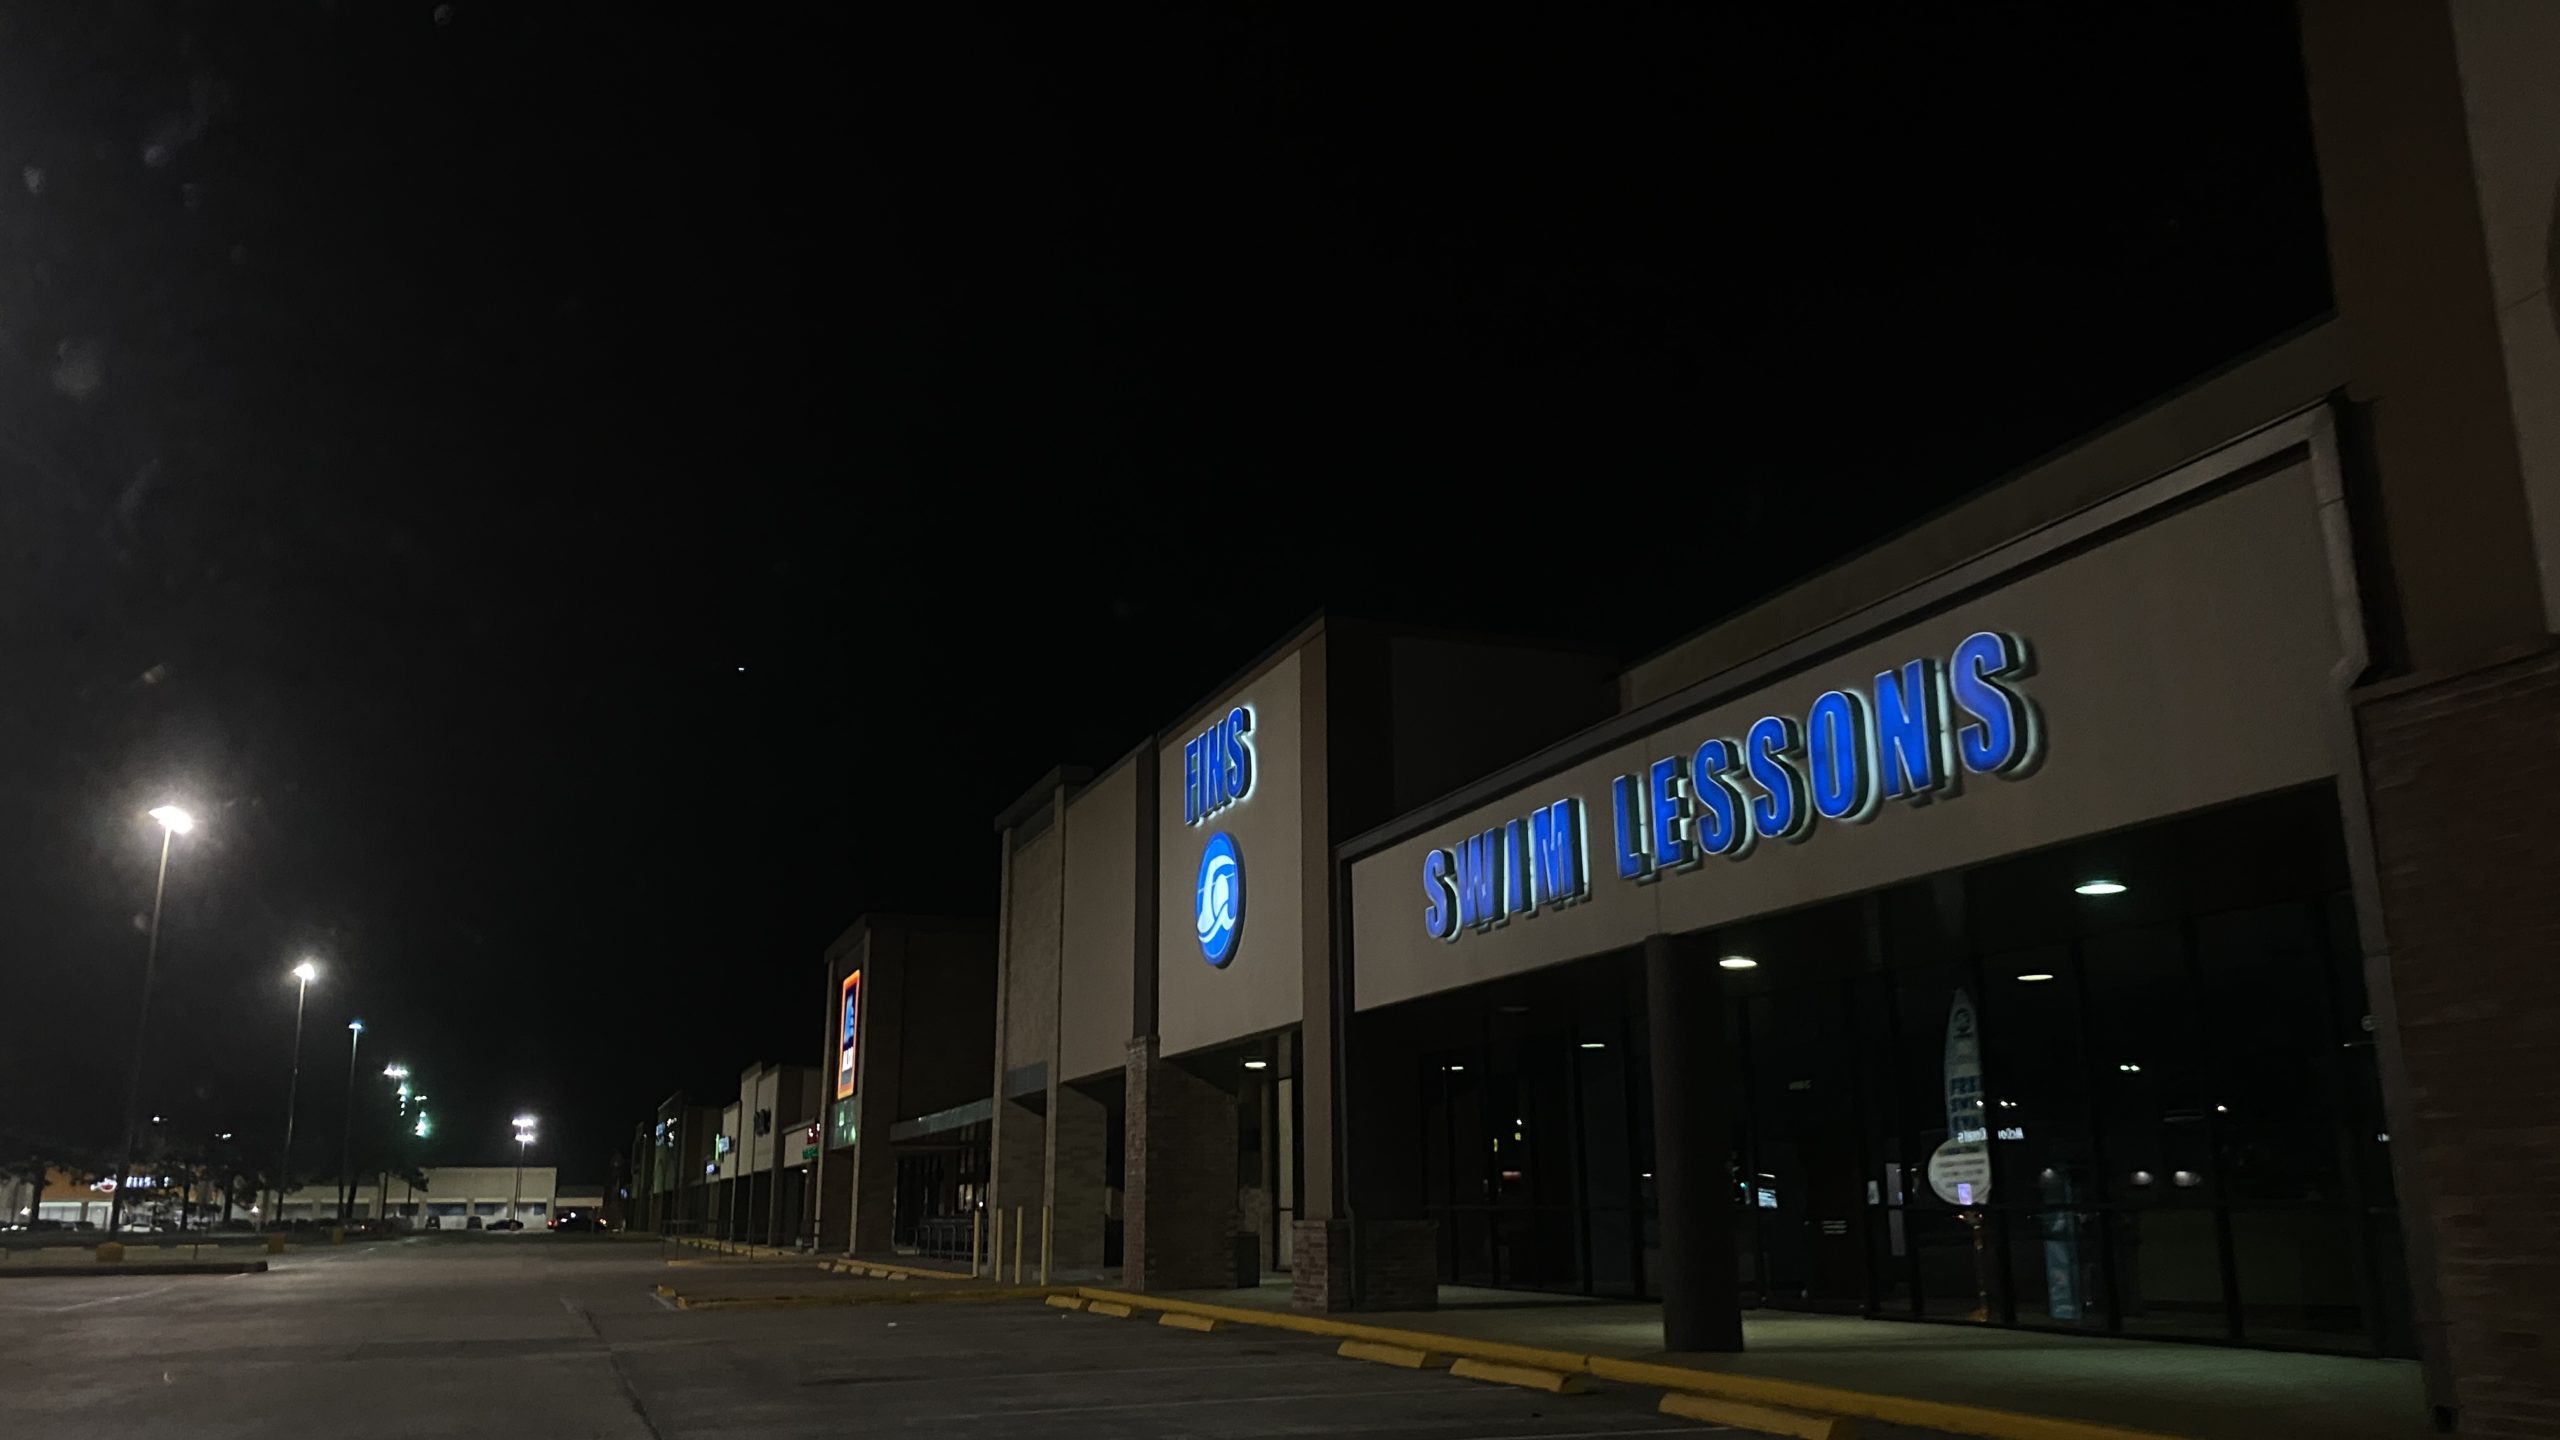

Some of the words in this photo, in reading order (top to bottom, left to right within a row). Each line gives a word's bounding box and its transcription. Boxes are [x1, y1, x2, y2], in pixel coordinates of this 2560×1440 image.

[1184, 706, 1251, 826] FINS
[1423, 798, 1585, 939] SWIM
[1612, 631, 2022, 879] LESSONS
